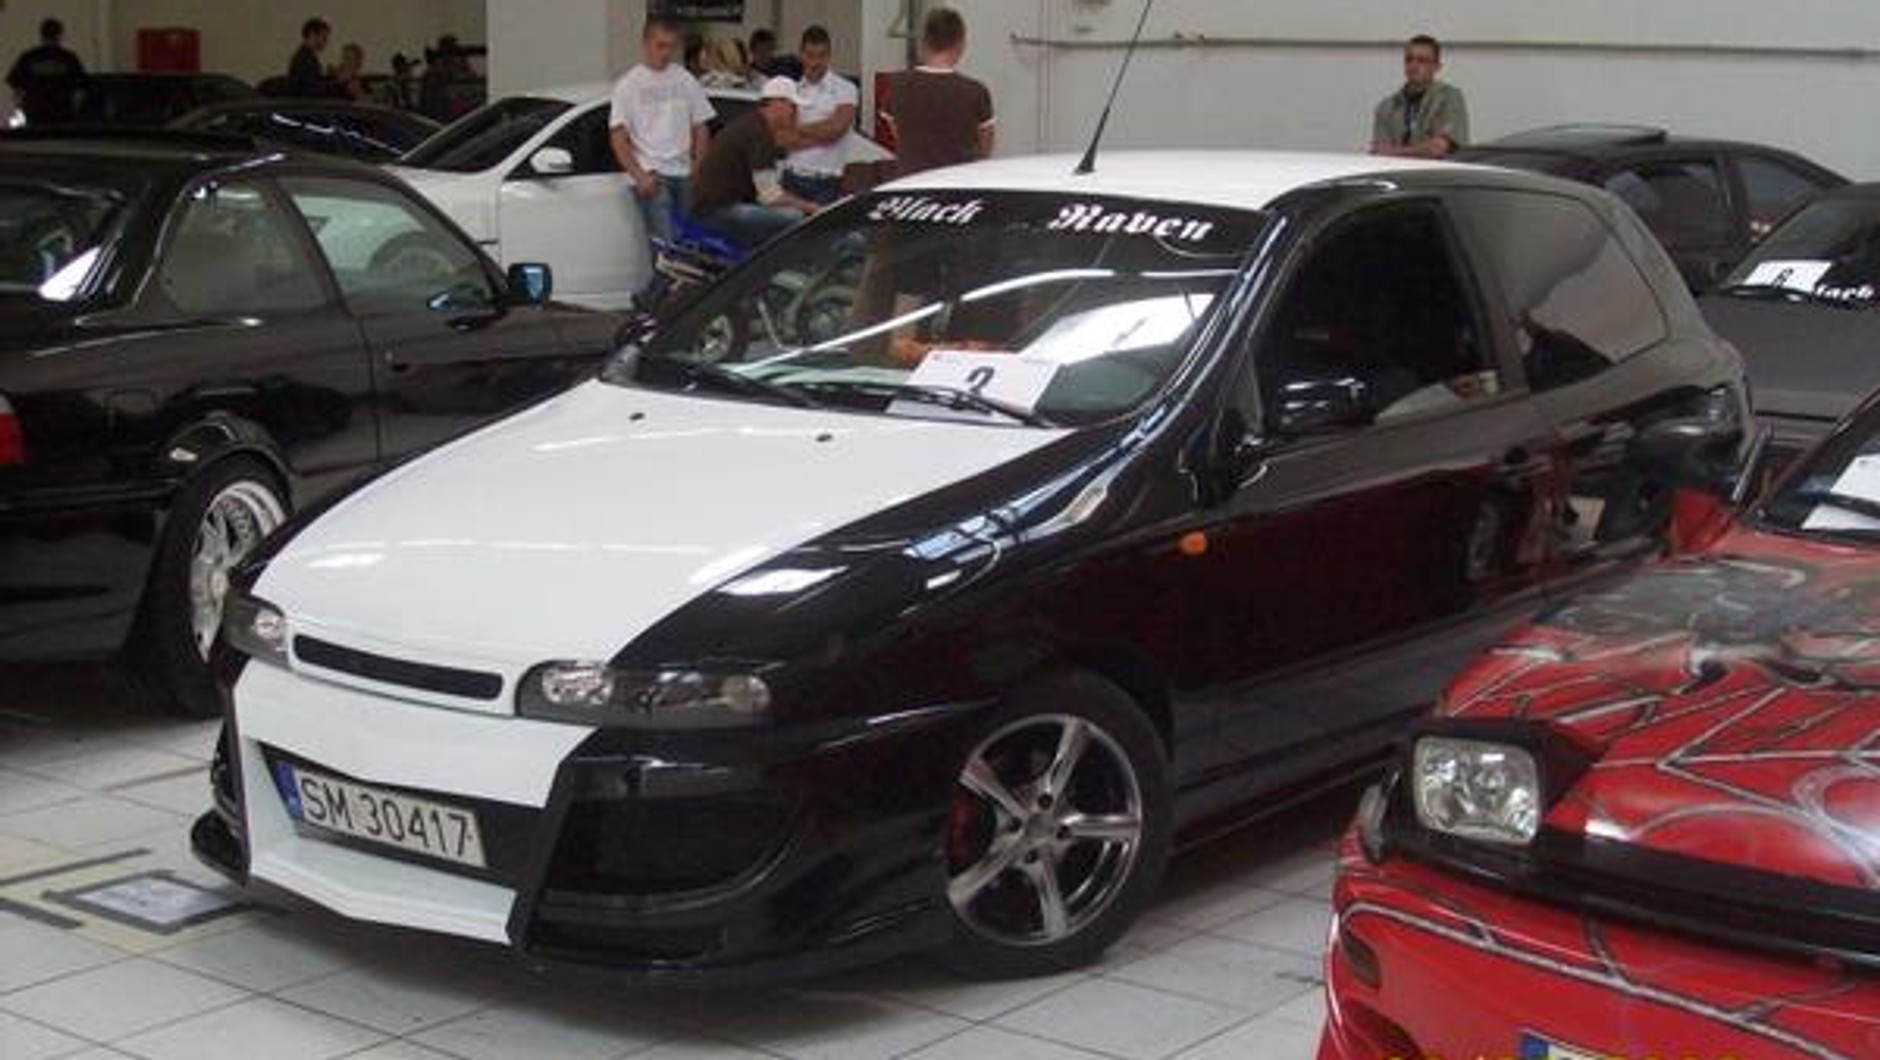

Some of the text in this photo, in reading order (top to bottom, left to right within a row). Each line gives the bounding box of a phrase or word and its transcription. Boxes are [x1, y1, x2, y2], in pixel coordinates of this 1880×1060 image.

[868, 196, 1214, 242] Black Raven
[301, 778, 468, 857] SM 30417
